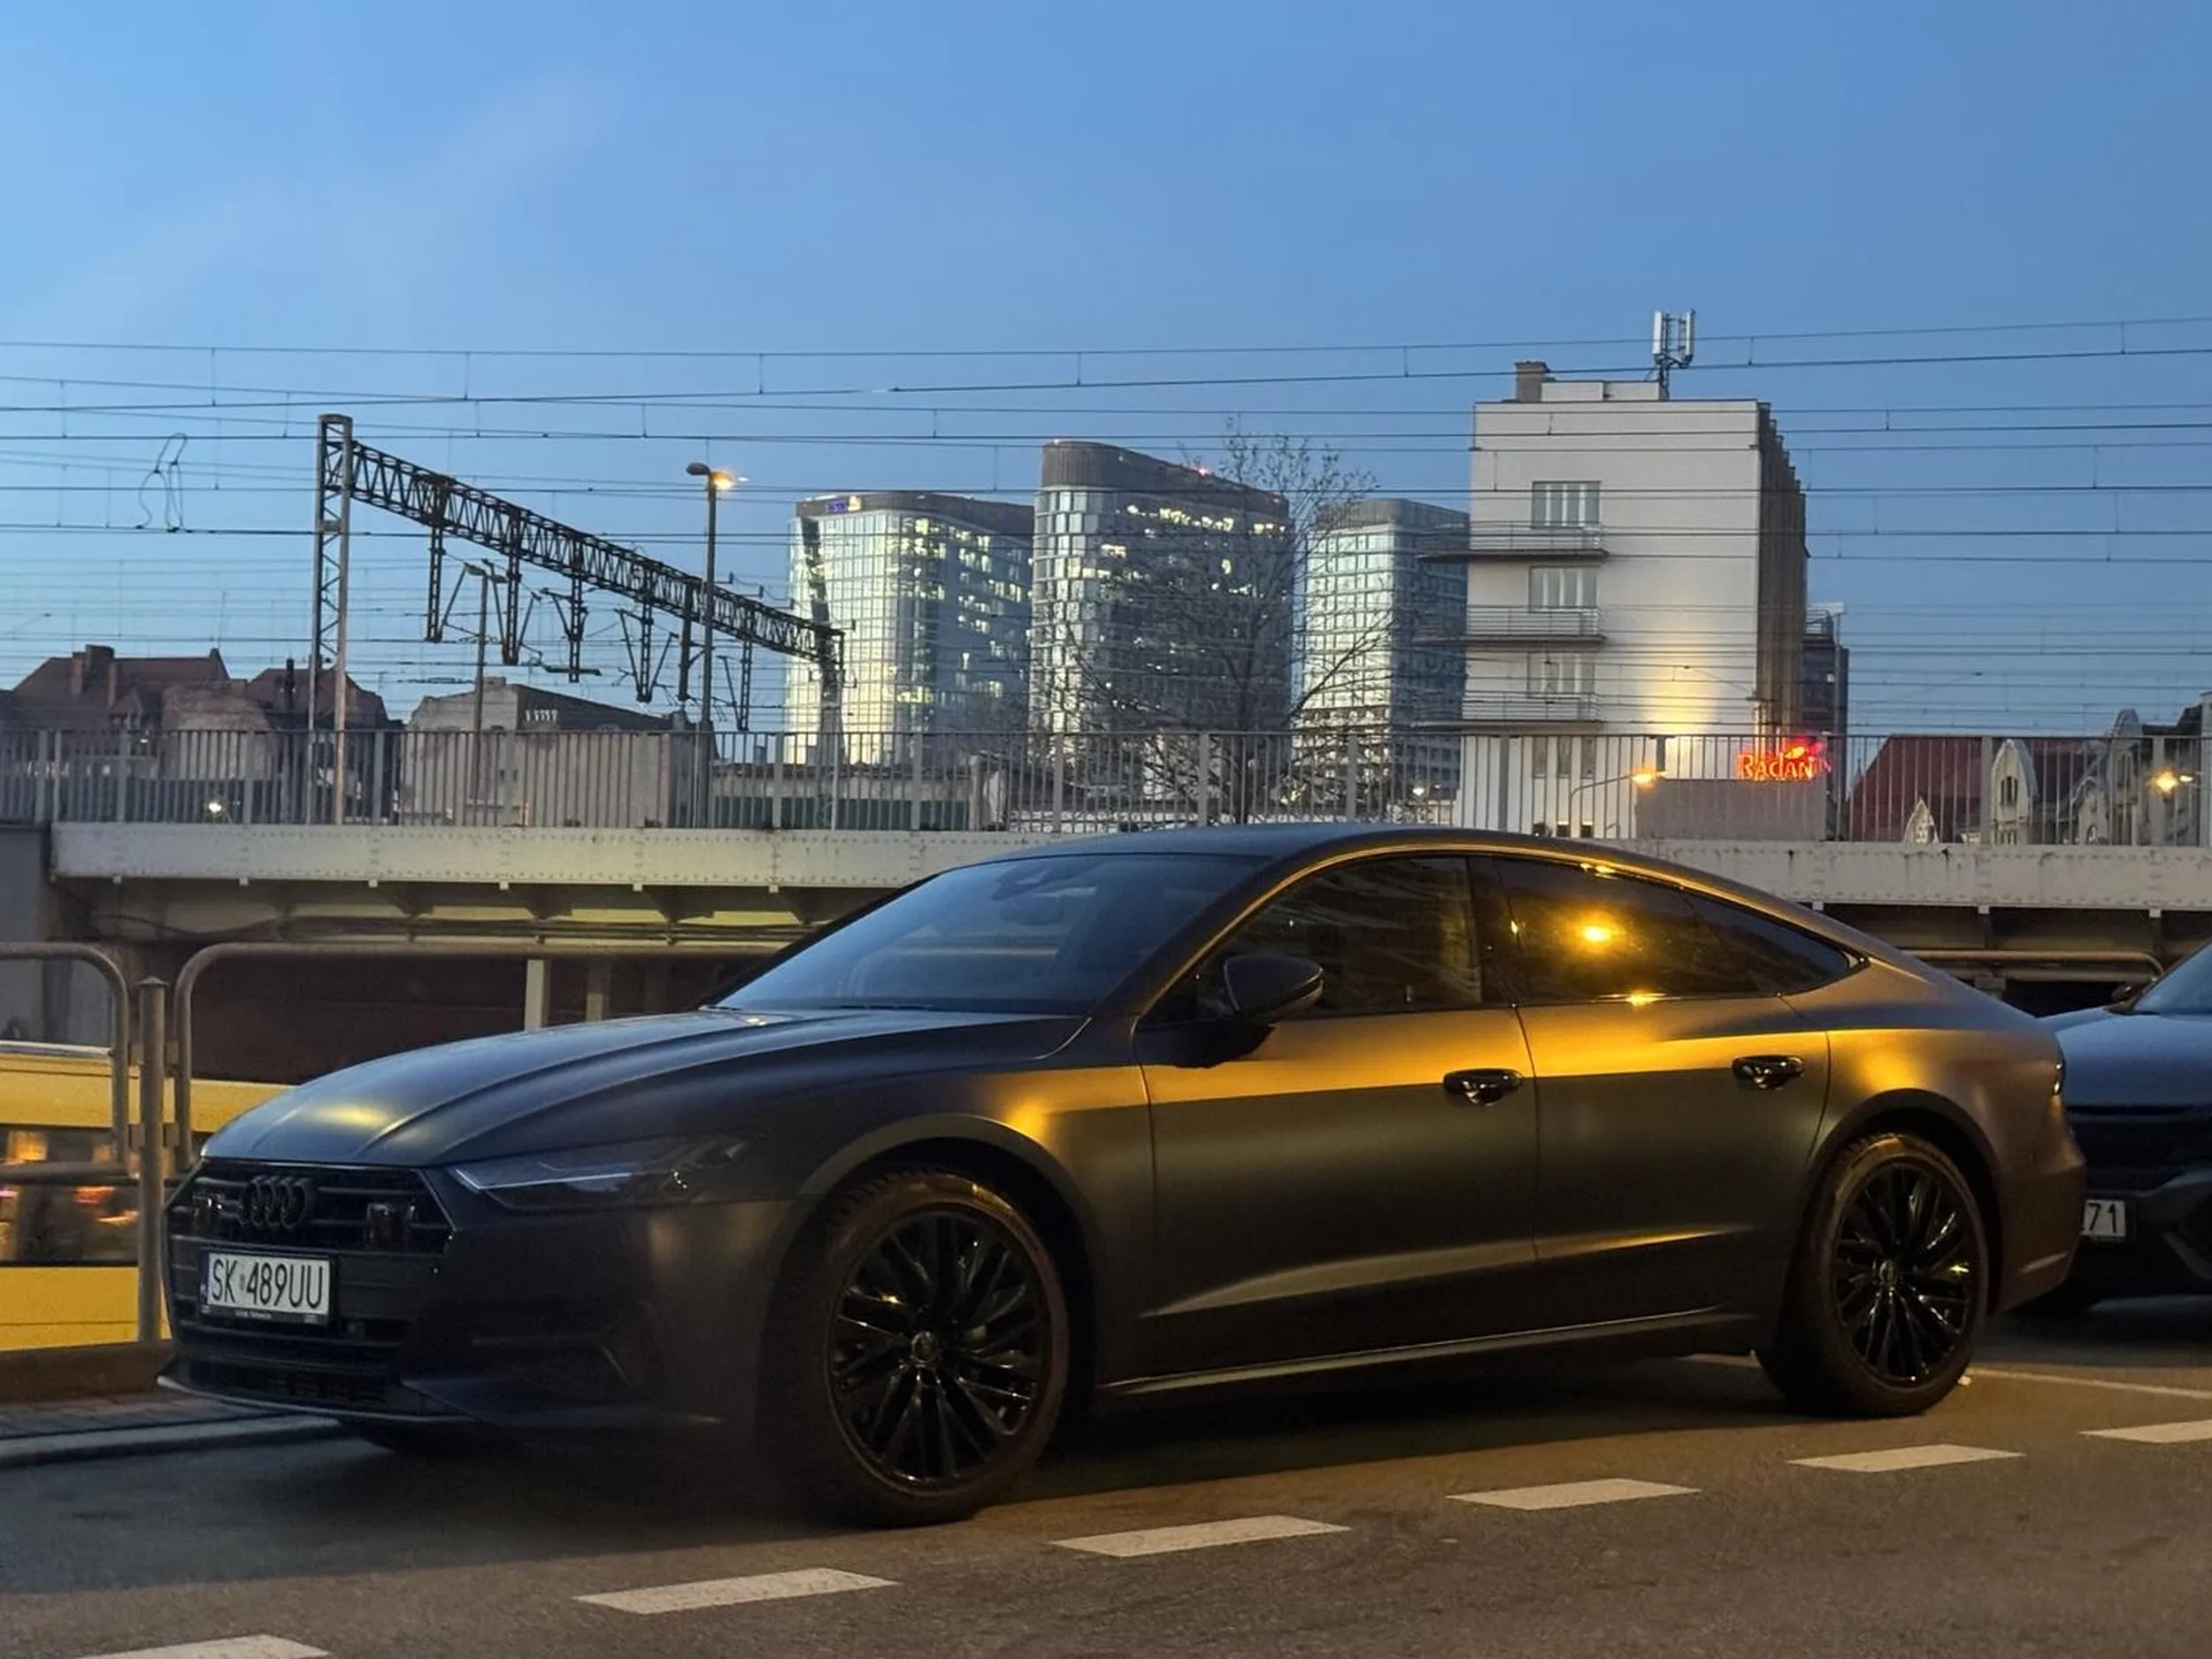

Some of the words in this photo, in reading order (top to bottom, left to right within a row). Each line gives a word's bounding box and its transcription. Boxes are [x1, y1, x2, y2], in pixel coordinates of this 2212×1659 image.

[2088, 1202, 2117, 1233] 71
[211, 1257, 240, 1304] SK
[246, 1261, 324, 1310] 489UU
